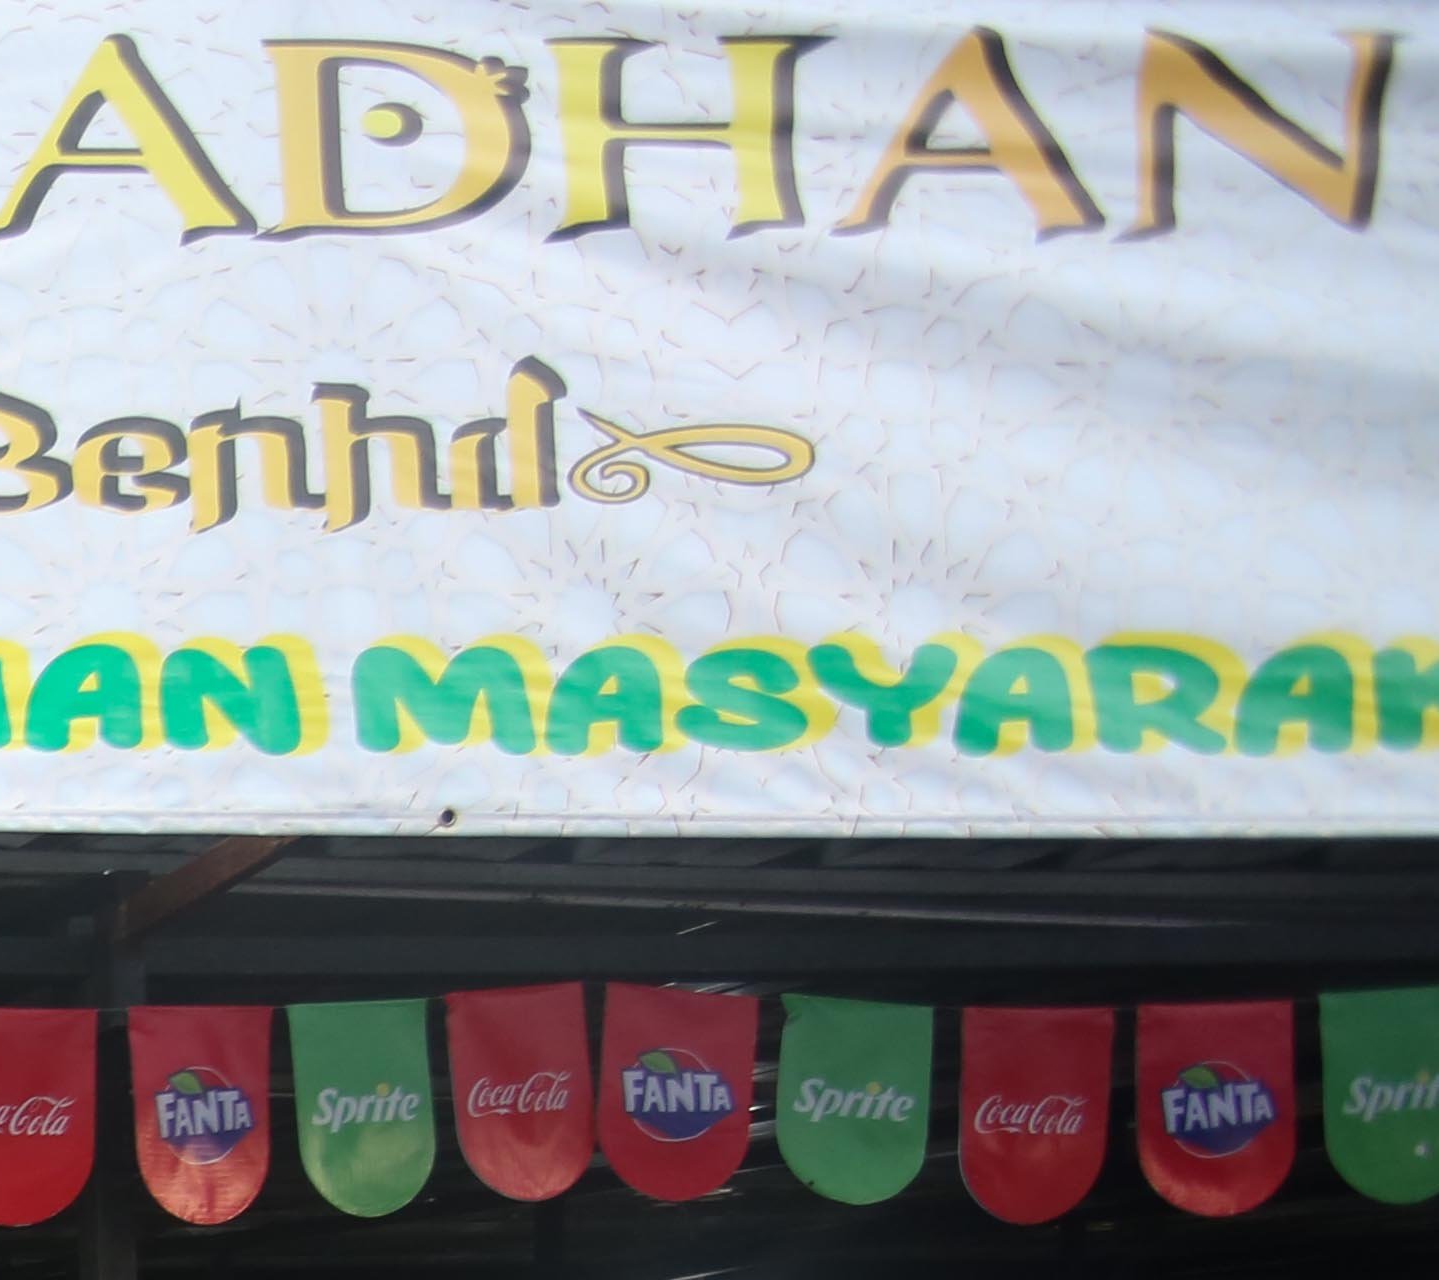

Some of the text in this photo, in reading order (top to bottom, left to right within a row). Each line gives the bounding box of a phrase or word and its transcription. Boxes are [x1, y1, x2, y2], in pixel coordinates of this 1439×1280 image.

[154, 1087, 253, 1142] FANTA
[311, 1080, 421, 1131] Sprite
[621, 1063, 734, 1118] FANTA
[792, 1074, 917, 1129] Sprite
[1162, 1079, 1275, 1133] FANTA
[1342, 1070, 1439, 1122] Sprit
